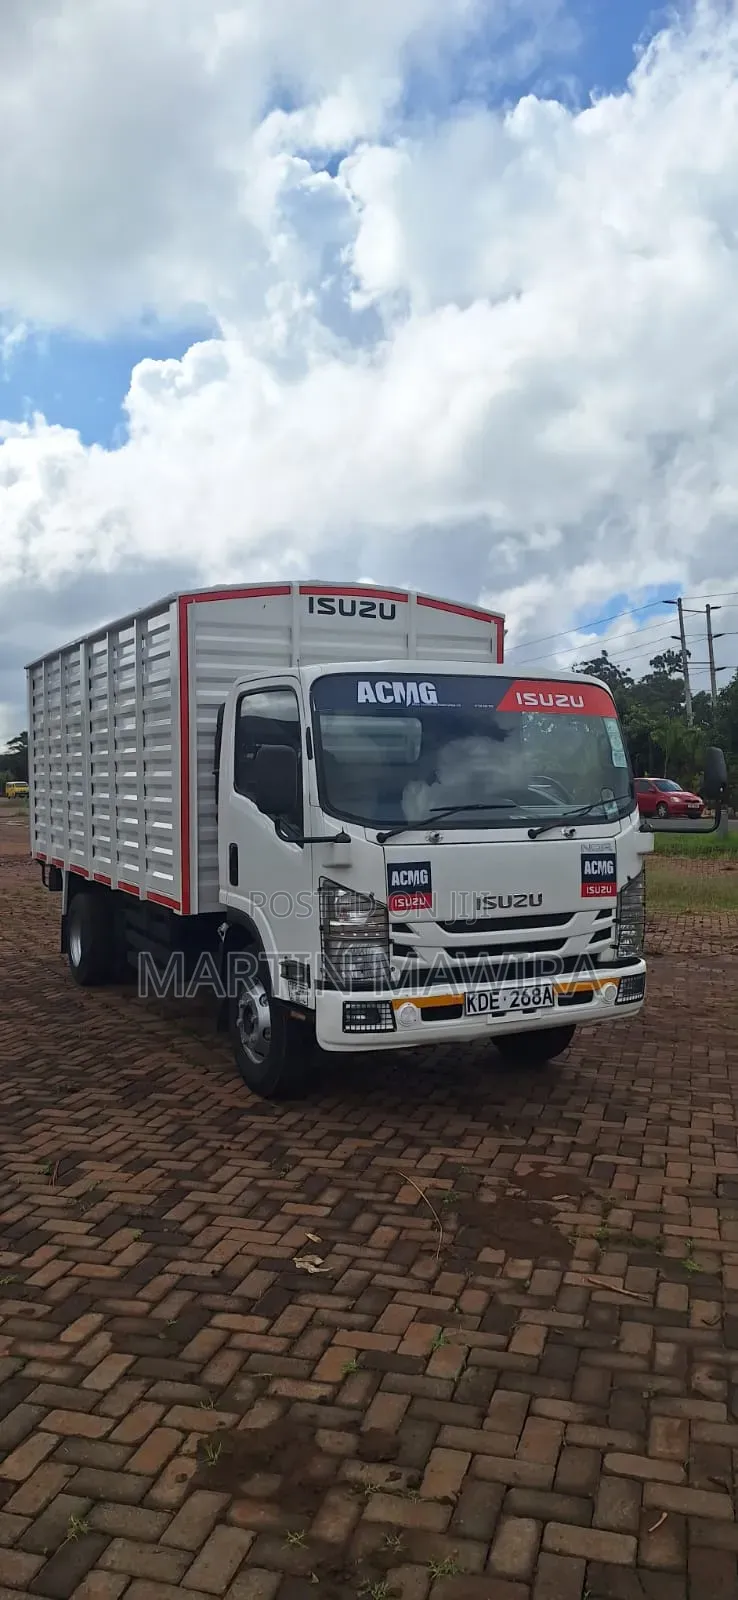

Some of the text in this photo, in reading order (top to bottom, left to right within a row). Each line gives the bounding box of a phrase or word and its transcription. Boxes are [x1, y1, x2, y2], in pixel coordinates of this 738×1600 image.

[308, 596, 396, 620] ISUZU
[357, 680, 438, 707] ACMG
[515, 692, 585, 708] ISUZU
[584, 860, 614, 875] ACMG
[391, 869, 429, 887] ACMG
[586, 886, 612, 894] ISUZU
[394, 897, 426, 907] ISUZU
[476, 893, 543, 910] ISUZU
[467, 985, 553, 1013] KDE 268A
